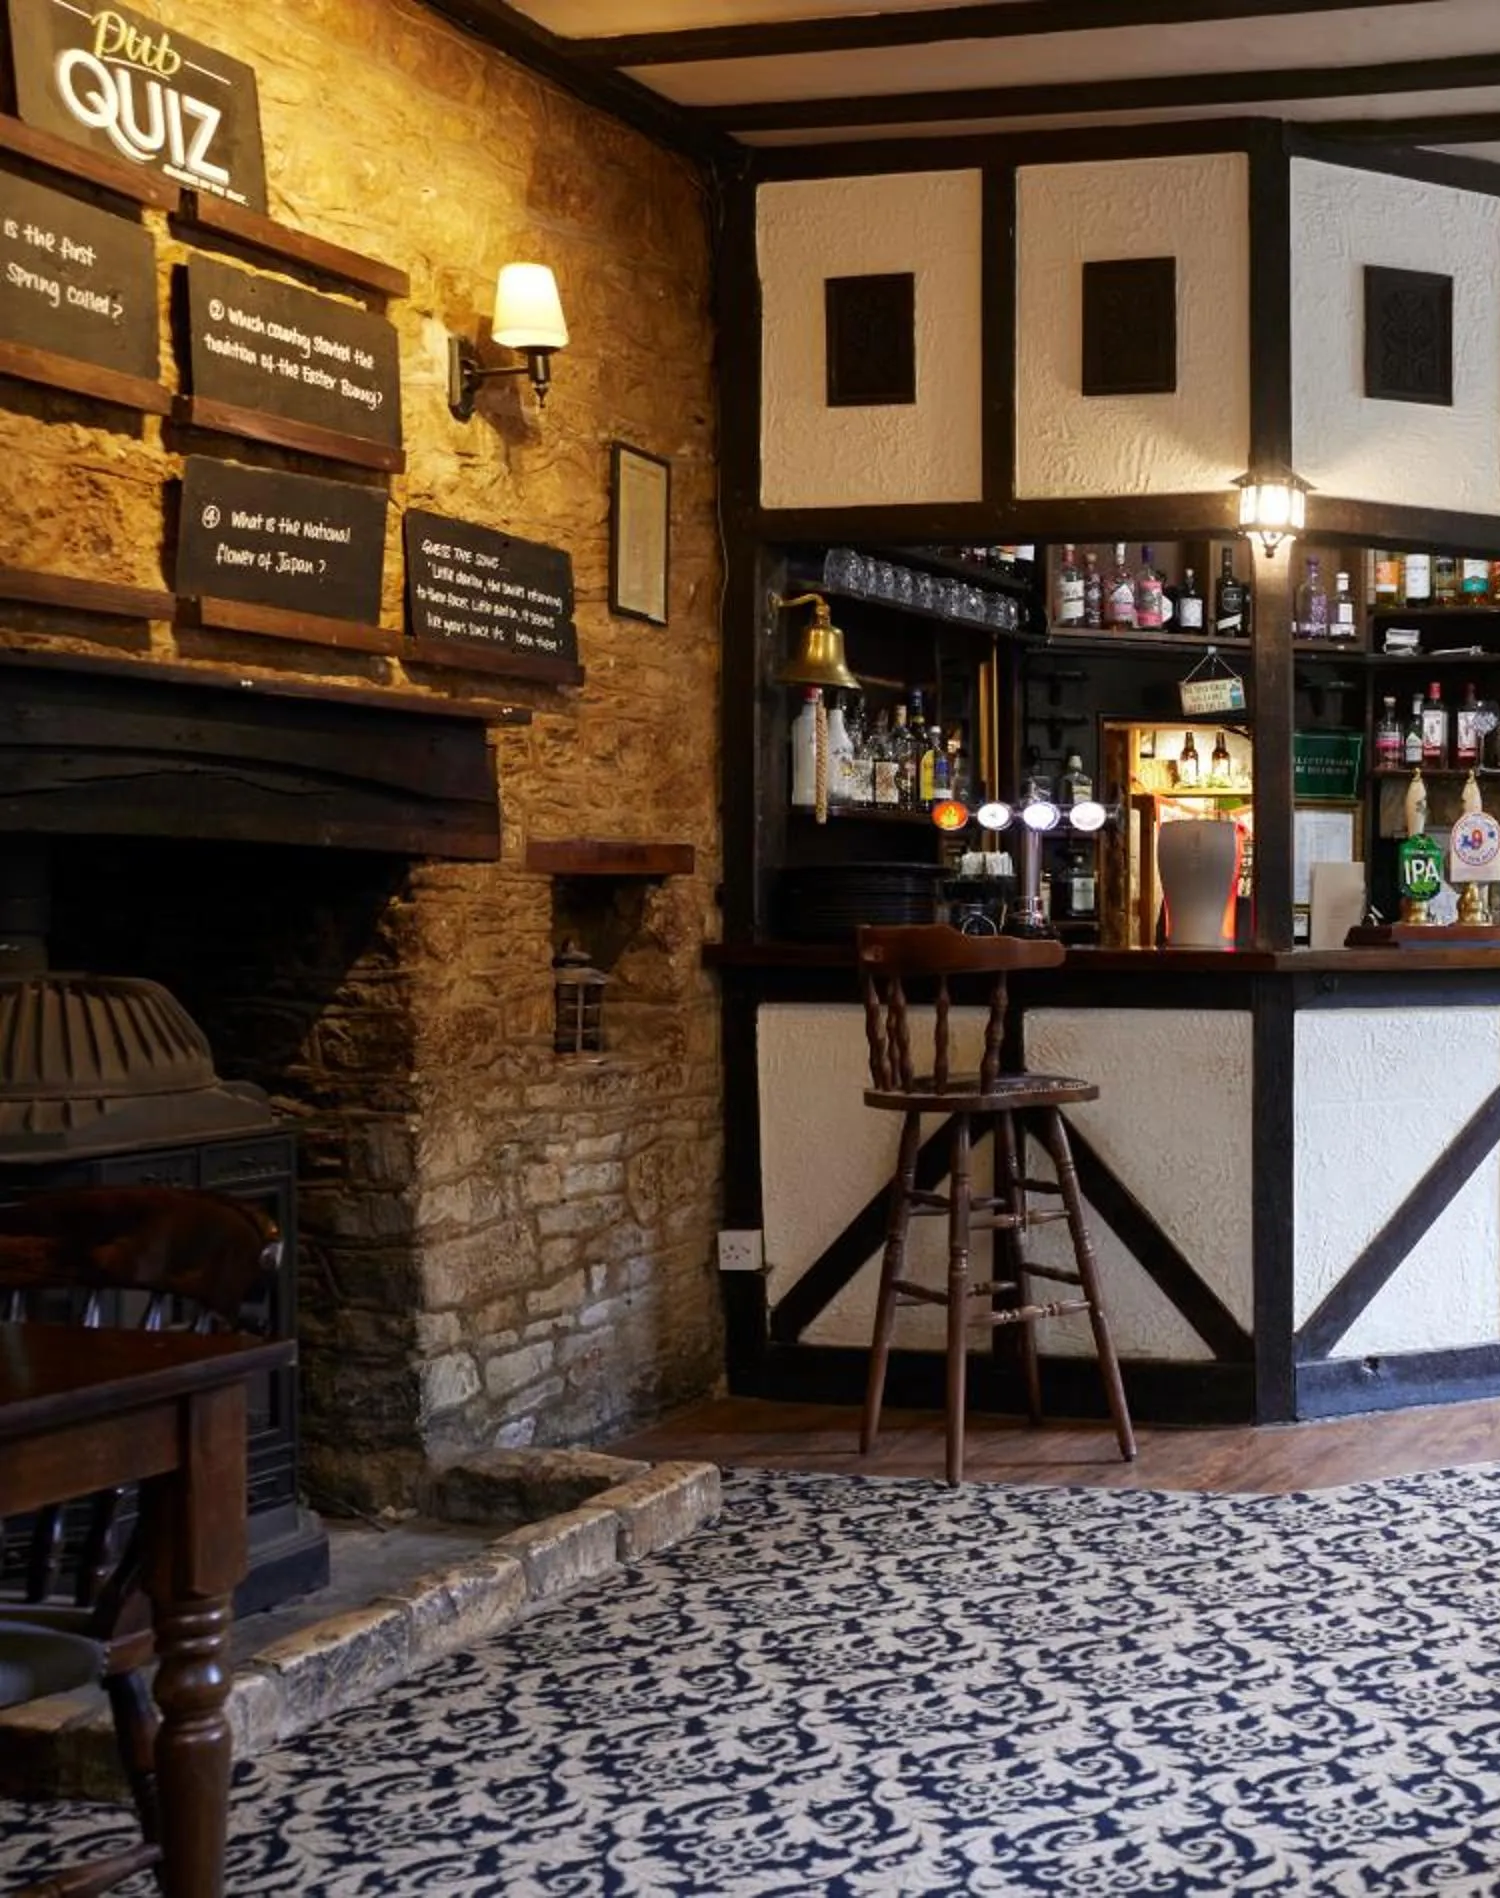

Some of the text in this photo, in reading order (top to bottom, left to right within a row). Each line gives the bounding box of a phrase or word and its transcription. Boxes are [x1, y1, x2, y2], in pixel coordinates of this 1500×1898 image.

[91, 11, 181, 75] Pub
[58, 49, 230, 185] QUIZ
[23, 224, 55, 252] the
[231, 511, 264, 531] What
[278, 517, 300, 537] the
[216, 542, 256, 566] flower
[258, 552, 272, 572] of
[275, 551, 314, 576] Japan
[453, 547, 473, 563] THE
[1403, 858, 1440, 885] IPA
